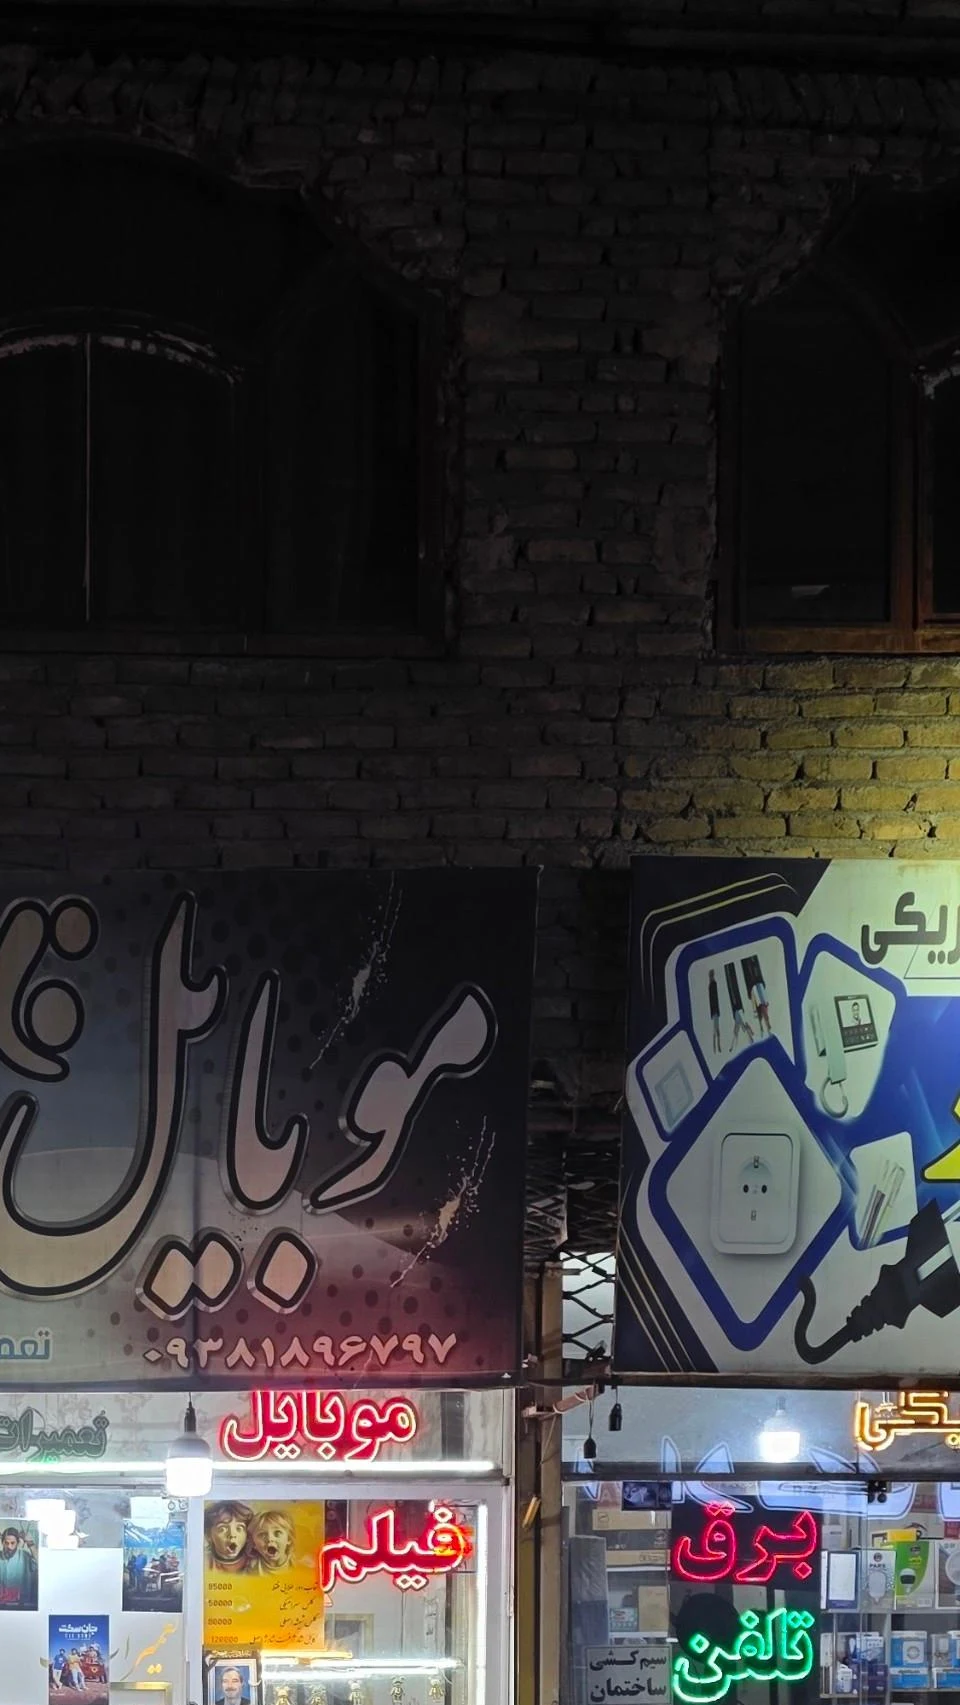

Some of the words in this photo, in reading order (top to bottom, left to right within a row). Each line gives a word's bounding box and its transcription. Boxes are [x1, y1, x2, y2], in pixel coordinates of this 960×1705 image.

[221, 1391, 418, 1462] موبایل
[319, 1506, 465, 1593] فیلم
[675, 1500, 818, 1583] برق
[589, 1650, 640, 1671] کشی
[590, 1677, 667, 1702] ساختمان
[640, 1655, 667, 1670] سیم
[672, 1607, 816, 1703] تلفن
